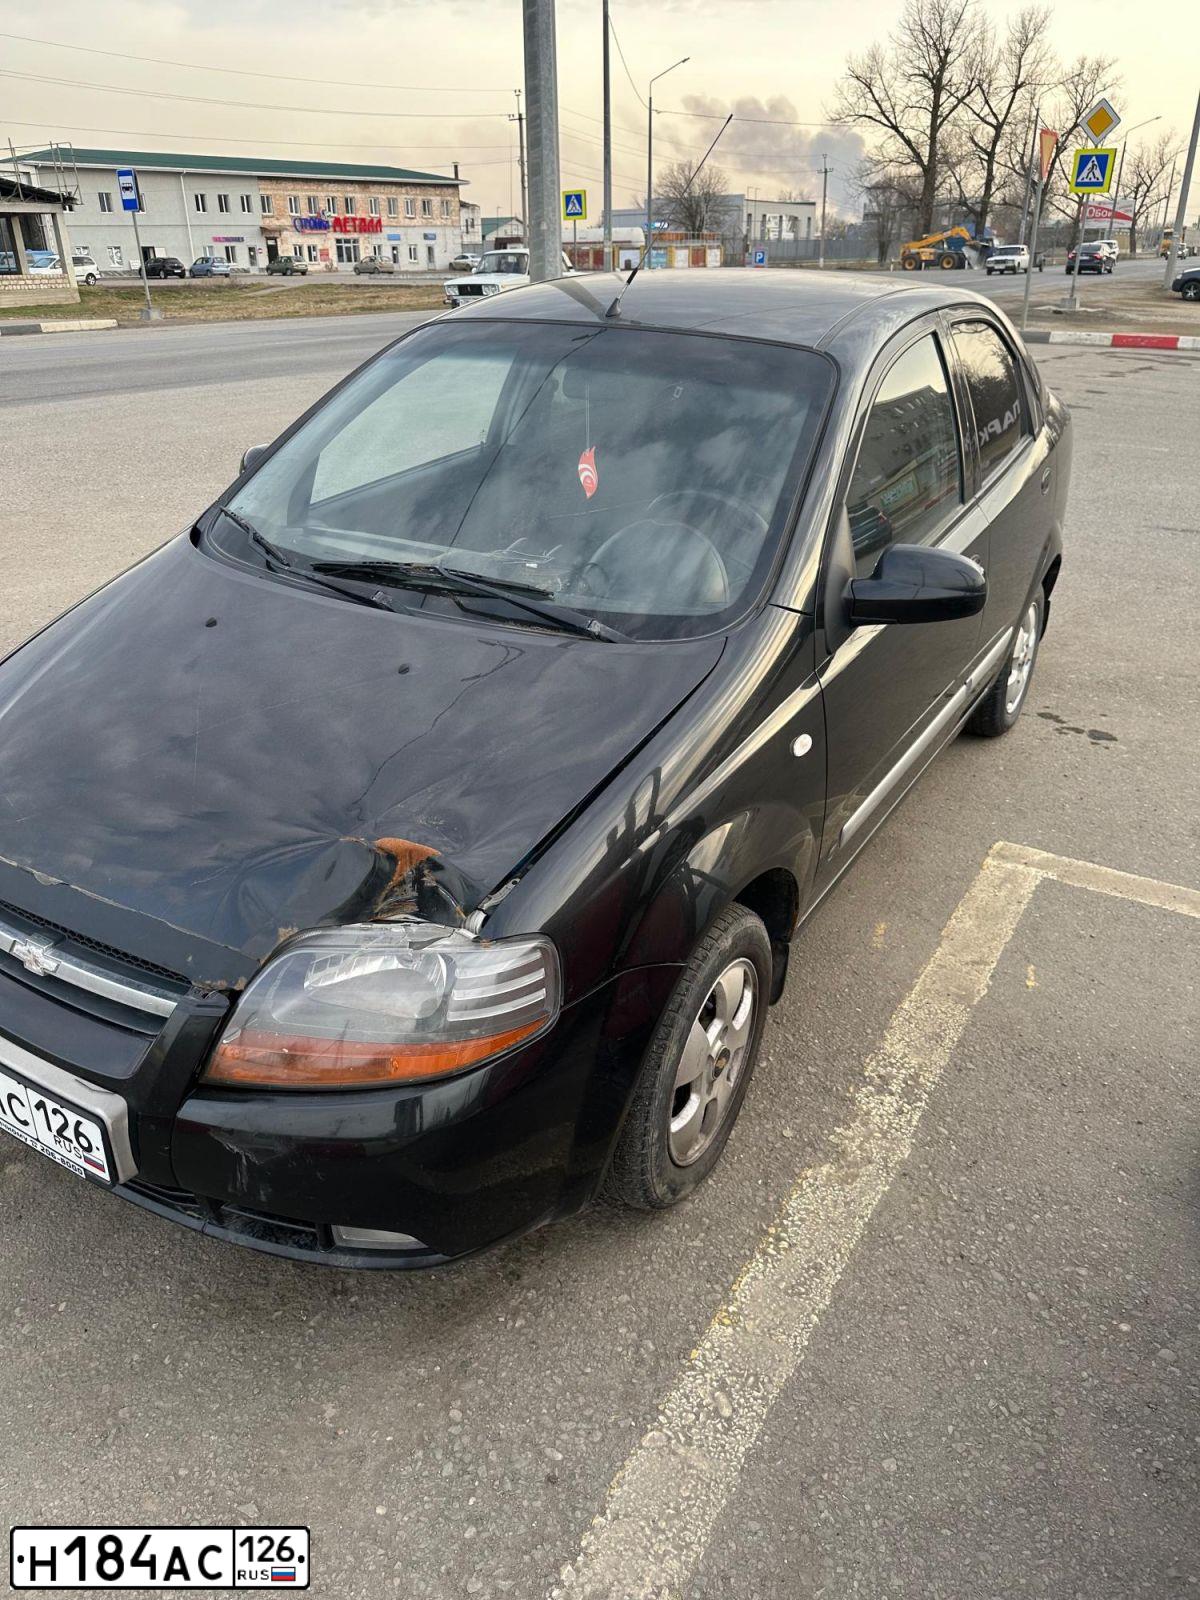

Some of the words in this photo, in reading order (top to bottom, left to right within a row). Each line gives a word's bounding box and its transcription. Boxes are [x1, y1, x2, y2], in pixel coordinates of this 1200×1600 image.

[332, 215, 383, 233] МЕТАЛЛ
[34, 1099, 94, 1153] 126
[53, 1134, 83, 1160] RUS
